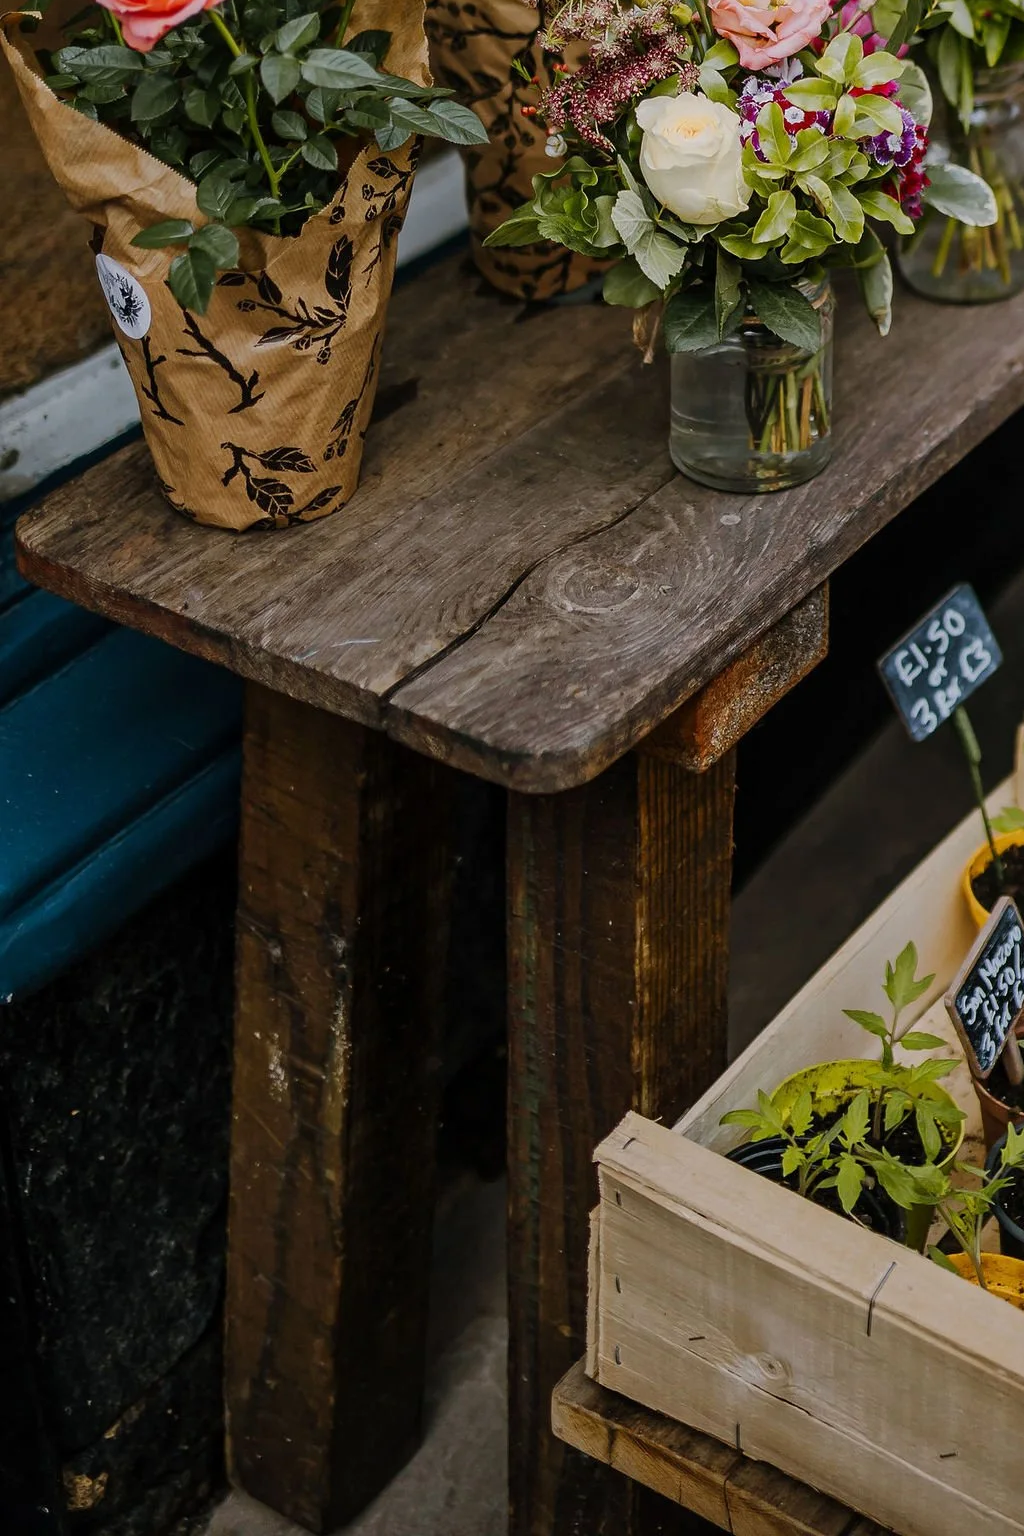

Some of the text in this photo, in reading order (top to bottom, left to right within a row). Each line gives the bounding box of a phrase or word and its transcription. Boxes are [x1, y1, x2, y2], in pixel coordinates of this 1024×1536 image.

[894, 608, 966, 688] £1.50
[910, 697, 938, 734] 3
[959, 637, 992, 683] £3
[961, 986, 987, 1025] San
[980, 1031, 996, 1063] 3
